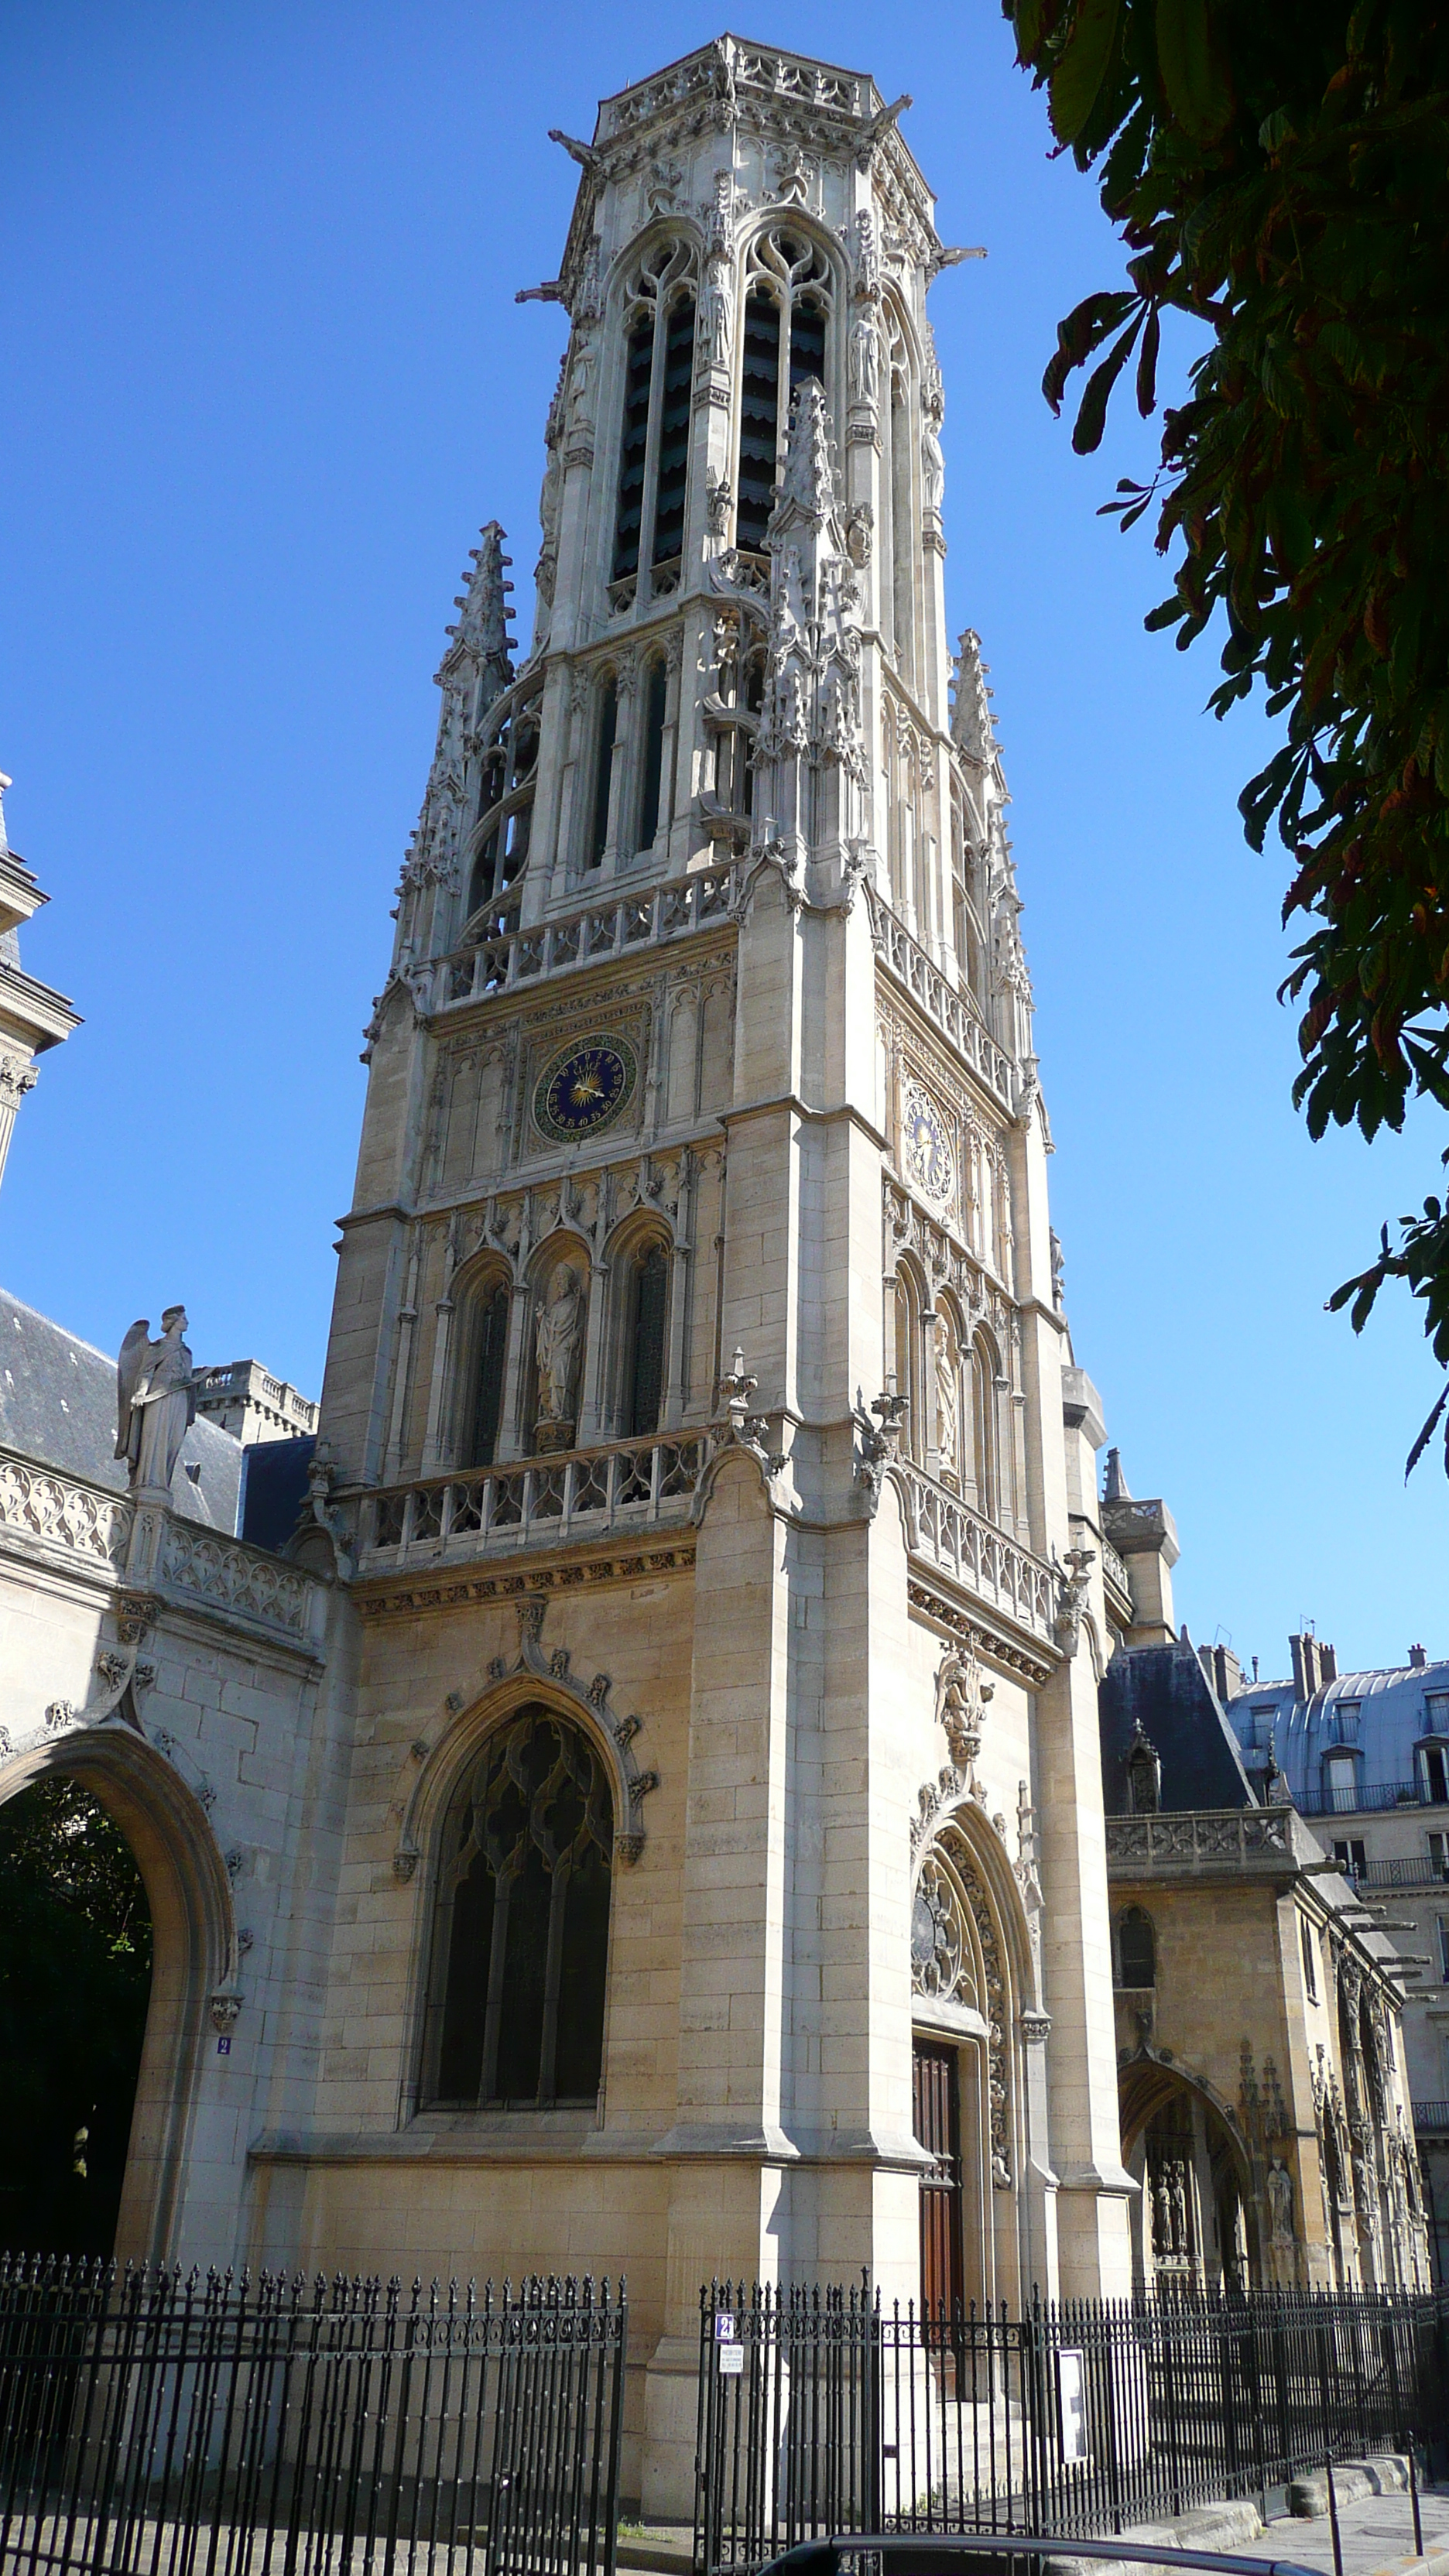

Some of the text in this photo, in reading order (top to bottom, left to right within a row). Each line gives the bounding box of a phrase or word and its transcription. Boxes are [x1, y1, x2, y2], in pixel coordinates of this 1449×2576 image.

[585, 1052, 591, 1060] 0
[578, 1118, 588, 1127] 40
[221, 2040, 228, 2053] 2
